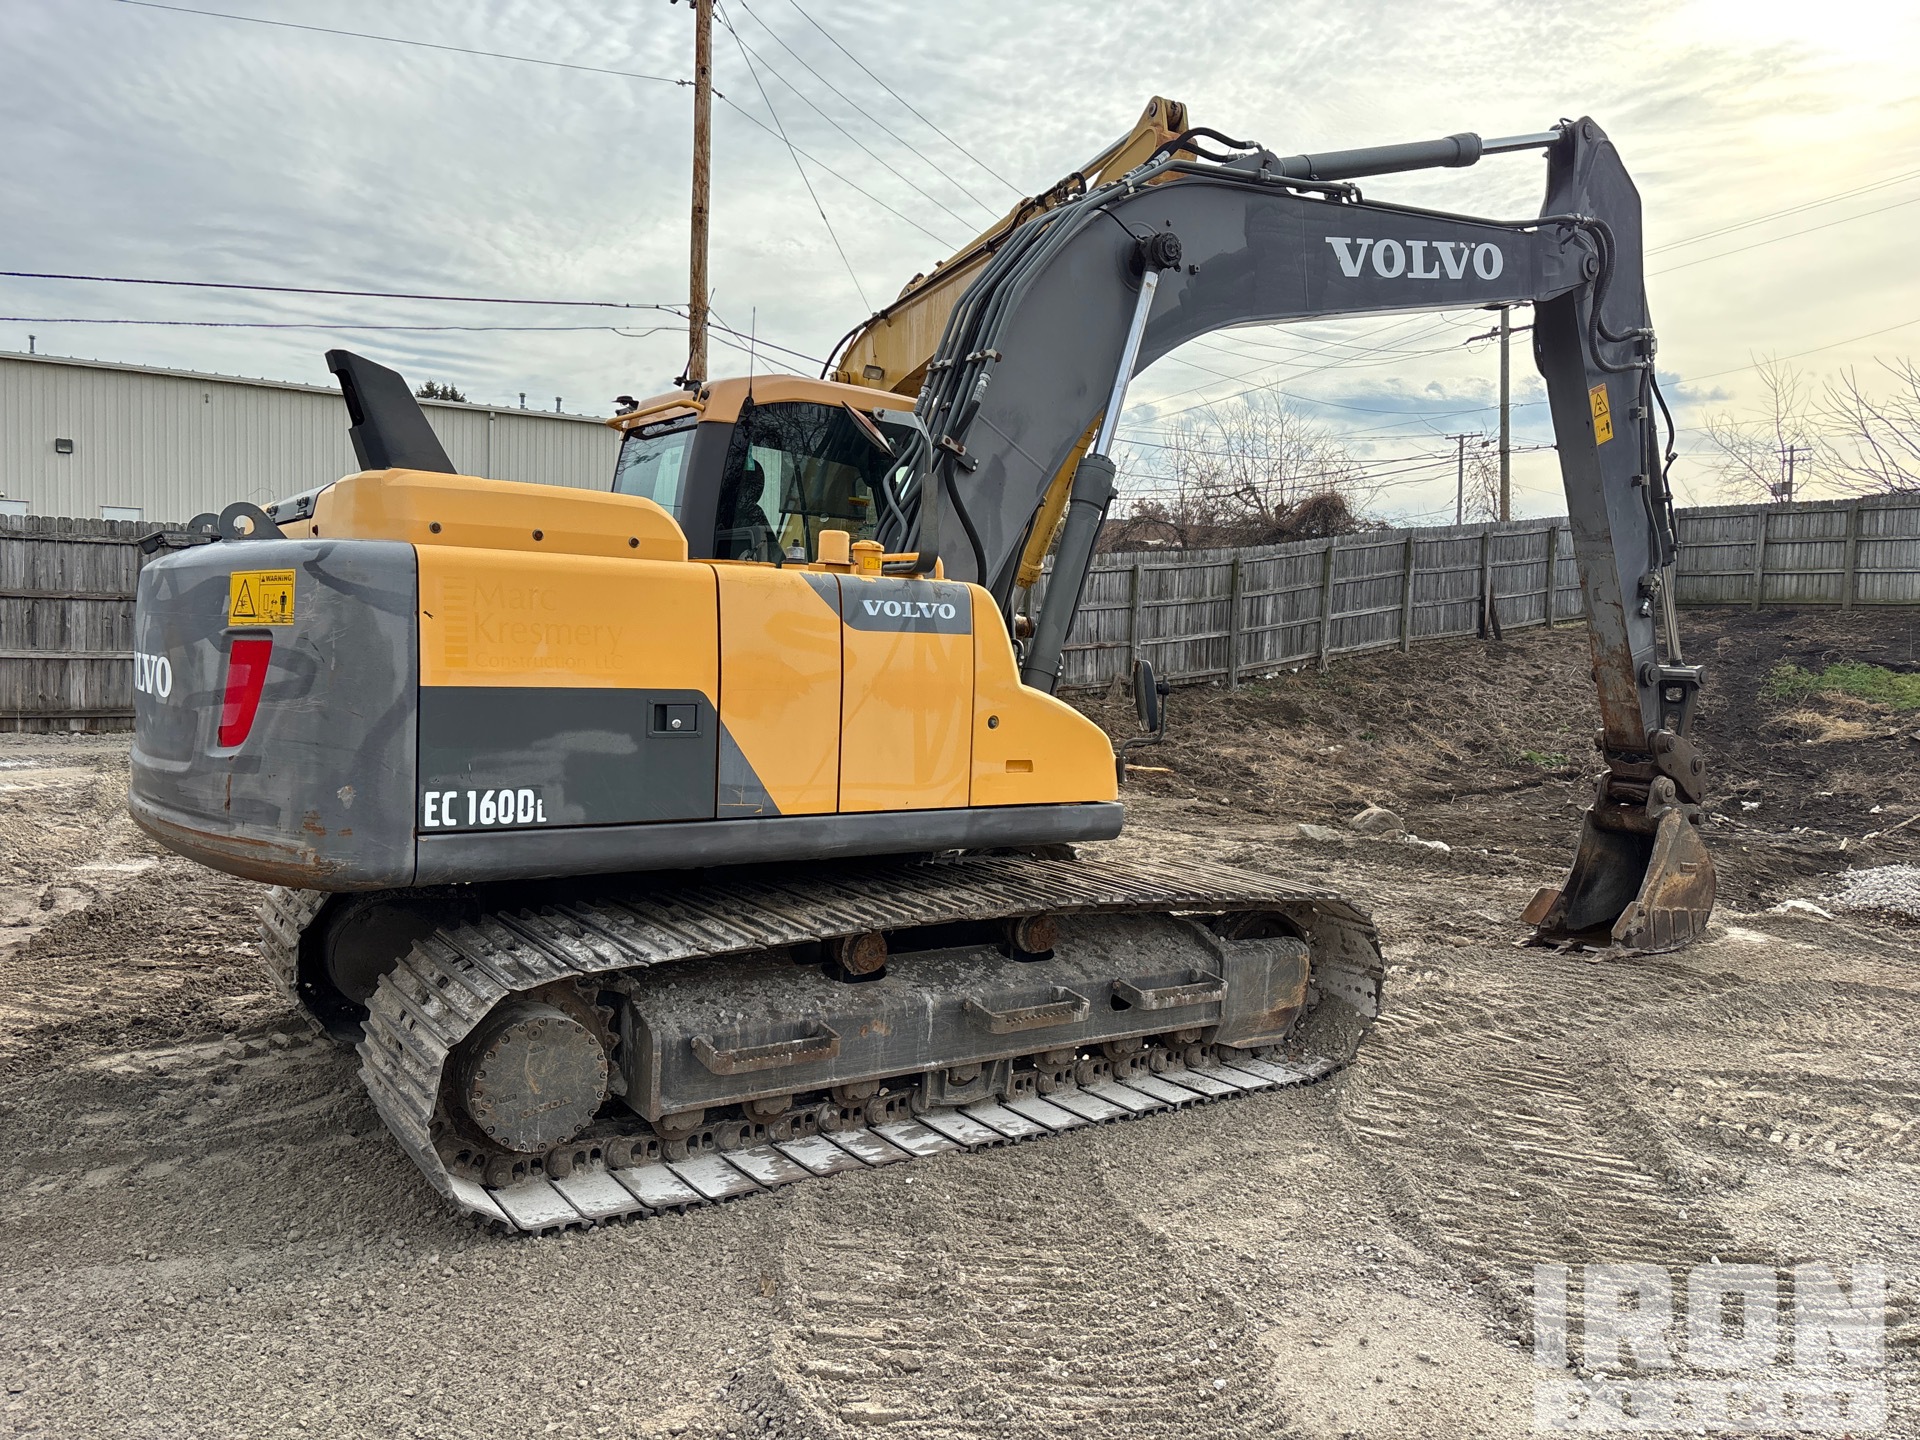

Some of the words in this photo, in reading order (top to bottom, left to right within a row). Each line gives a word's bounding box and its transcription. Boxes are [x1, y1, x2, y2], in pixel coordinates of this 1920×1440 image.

[1325, 236, 1504, 281] VOLVO
[265, 574, 292, 582] WARNING
[472, 575, 558, 612] Marc
[861, 599, 956, 620] VOLVO
[474, 612, 624, 655] Kresmery
[134, 651, 172, 698] LVO
[475, 652, 587, 669] Construction
[595, 653, 624, 670] LLC
[424, 791, 458, 827] EC
